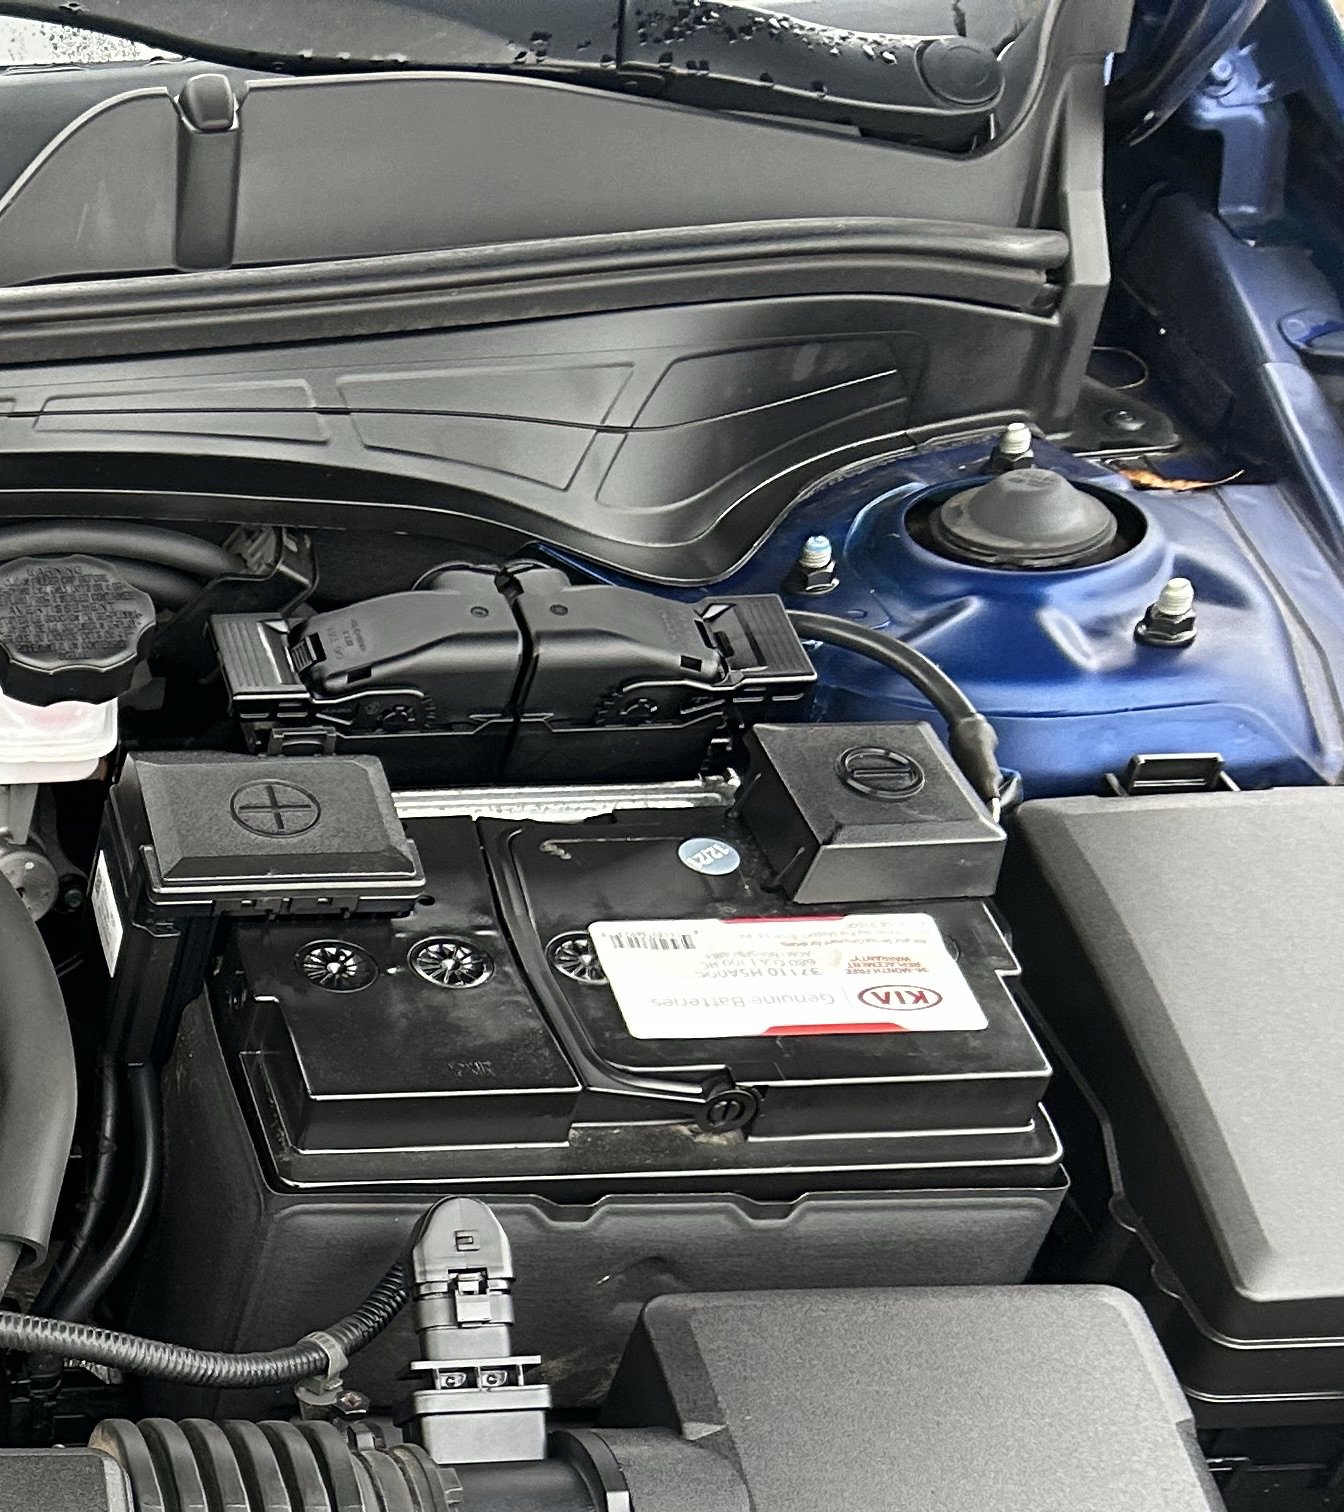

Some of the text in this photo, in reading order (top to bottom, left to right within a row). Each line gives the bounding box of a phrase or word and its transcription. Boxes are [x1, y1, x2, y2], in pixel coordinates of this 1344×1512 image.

[650, 992, 836, 1008] Genuine Batteries
[869, 988, 930, 1006] KIA
